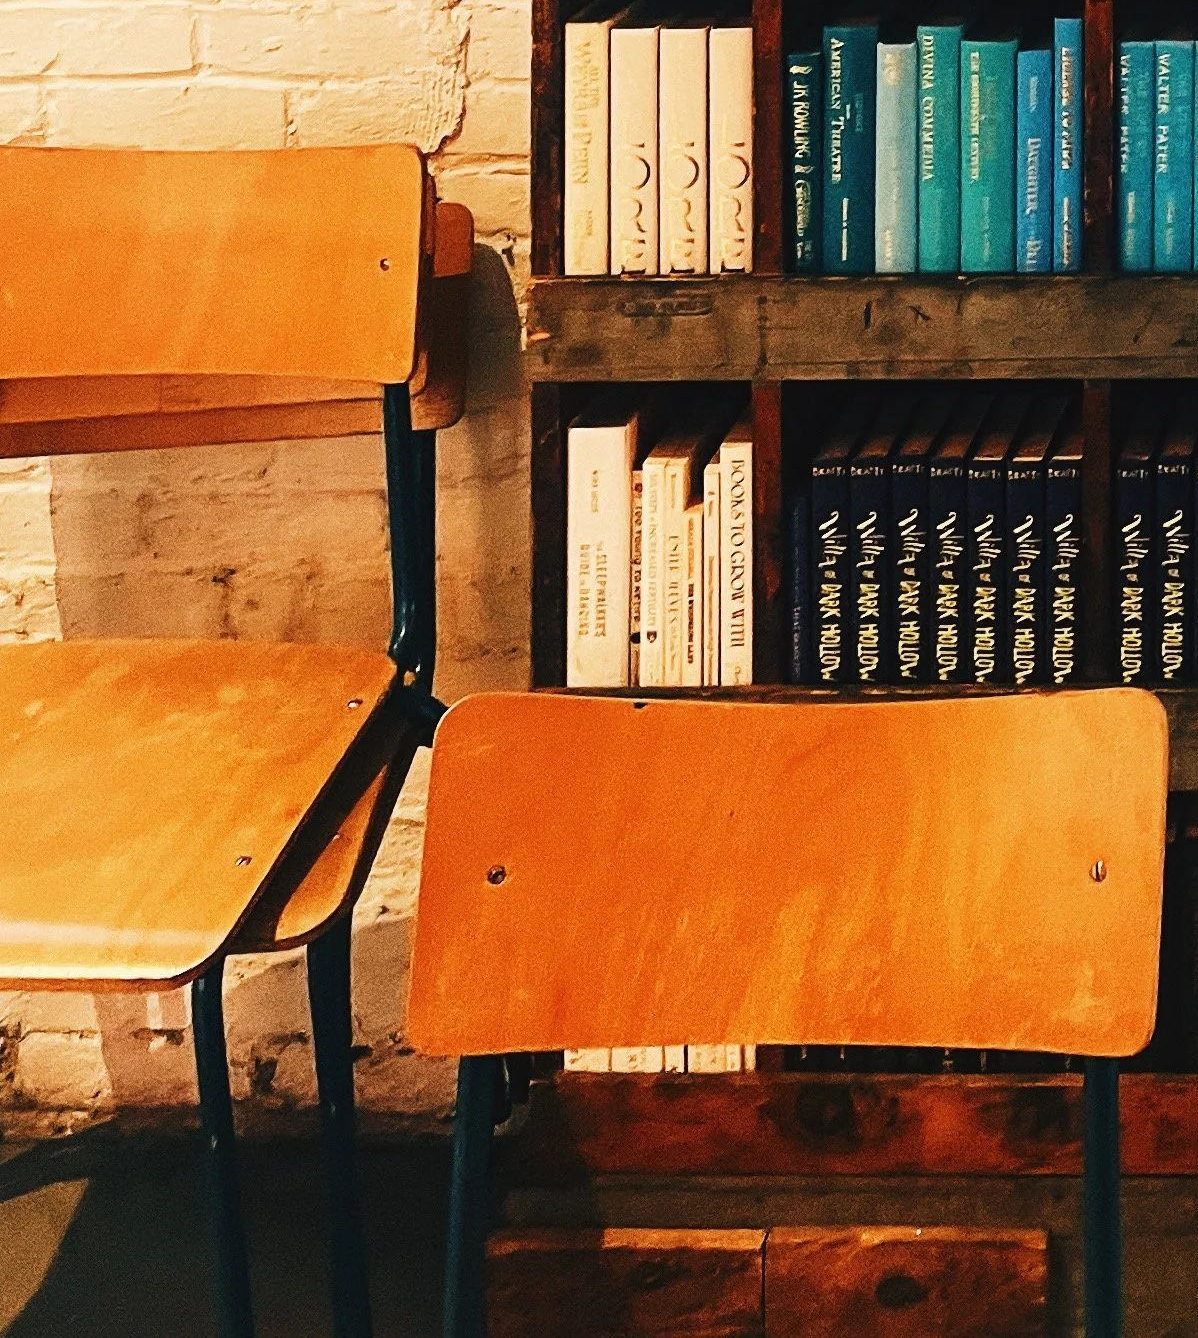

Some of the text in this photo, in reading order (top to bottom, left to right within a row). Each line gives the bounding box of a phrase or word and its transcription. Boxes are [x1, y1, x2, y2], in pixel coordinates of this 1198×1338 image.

[792, 81, 810, 158] JK ROWLING
[830, 38, 844, 183] AMERICAN THEATRE
[922, 35, 933, 181] DIVINA COMMEDIA
[730, 460, 745, 647] BOOKS TO GROW WITH
[1012, 515, 1041, 571] Willa
[1052, 514, 1079, 570] Willa
[1014, 588, 1036, 622] DARK
[1054, 587, 1076, 621] DARK
